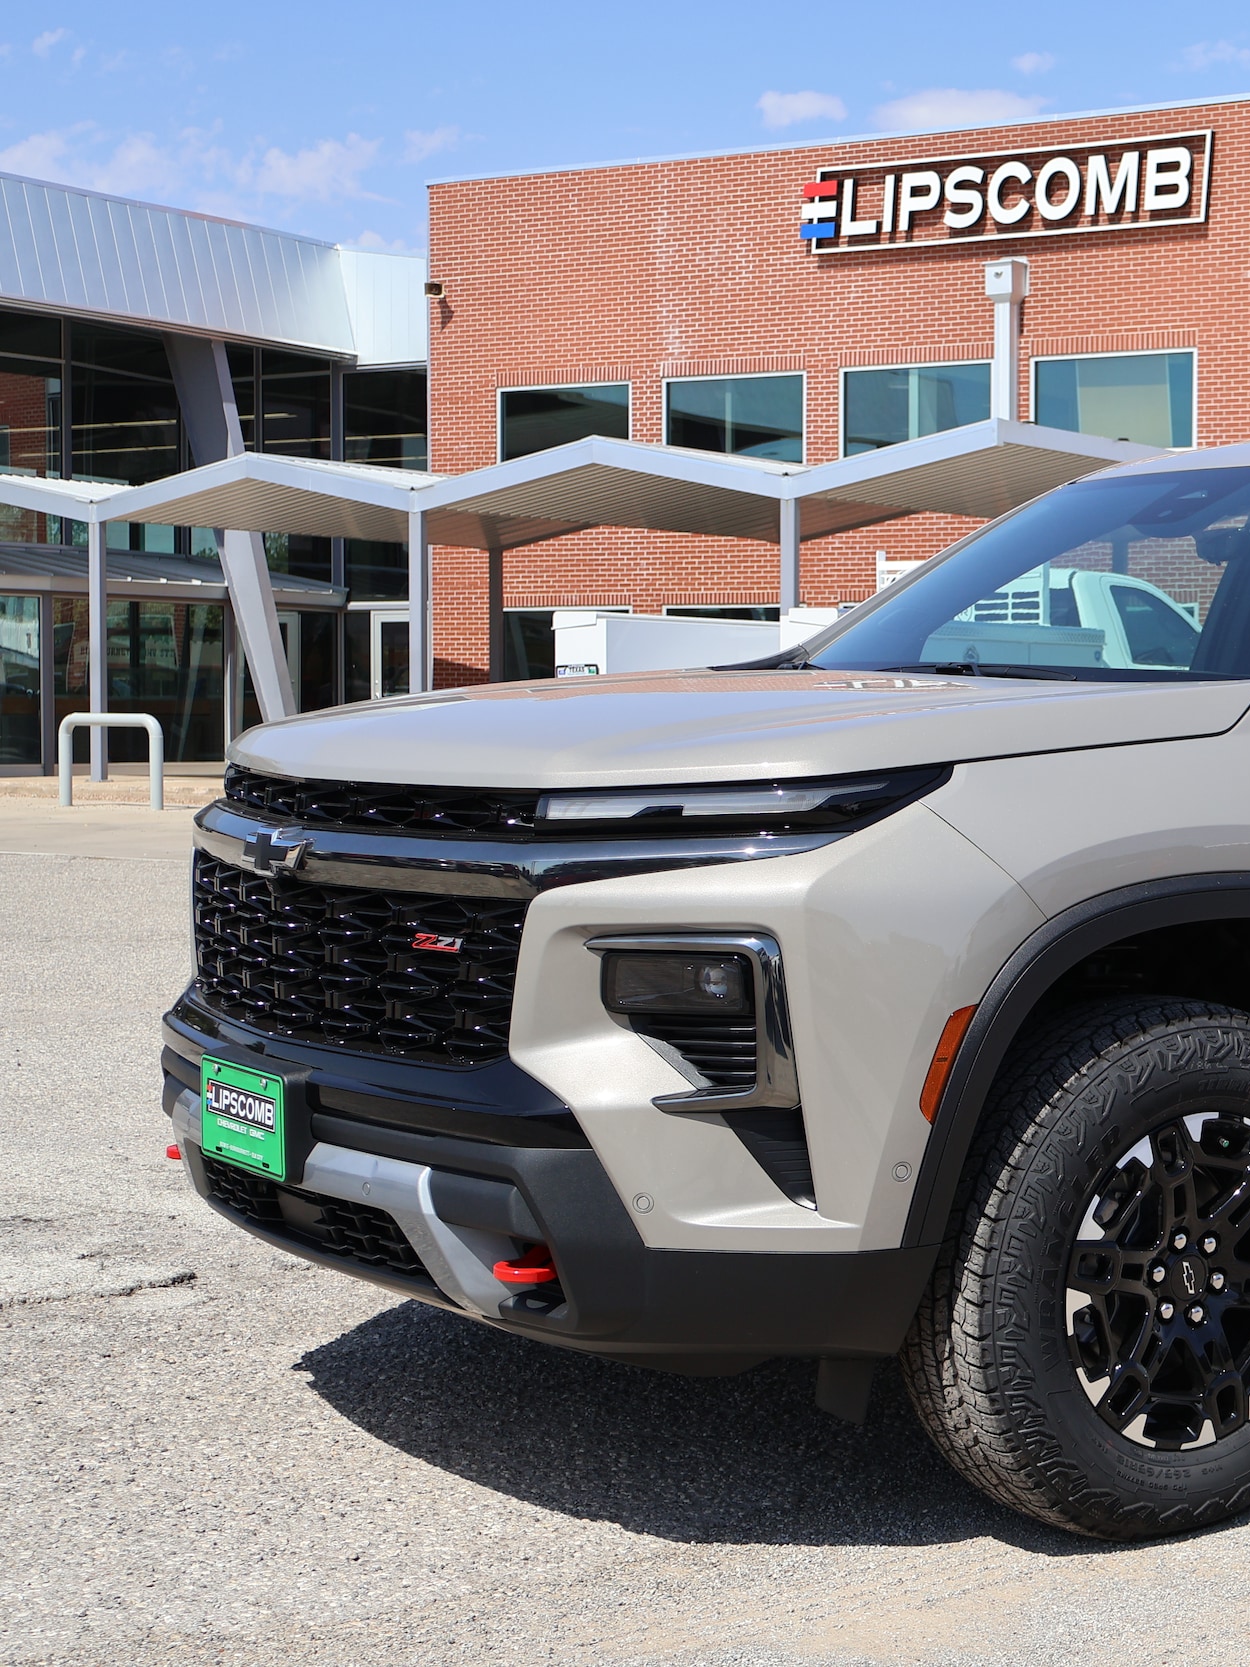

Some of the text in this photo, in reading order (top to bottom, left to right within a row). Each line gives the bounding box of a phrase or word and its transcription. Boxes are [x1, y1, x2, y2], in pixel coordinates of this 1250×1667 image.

[839, 146, 1193, 237] LIPSCOMB
[411, 933, 464, 953] Z71
[212, 1086, 274, 1126] LIPSCOMB
[216, 1117, 265, 1141] CHEVROLET GMC
